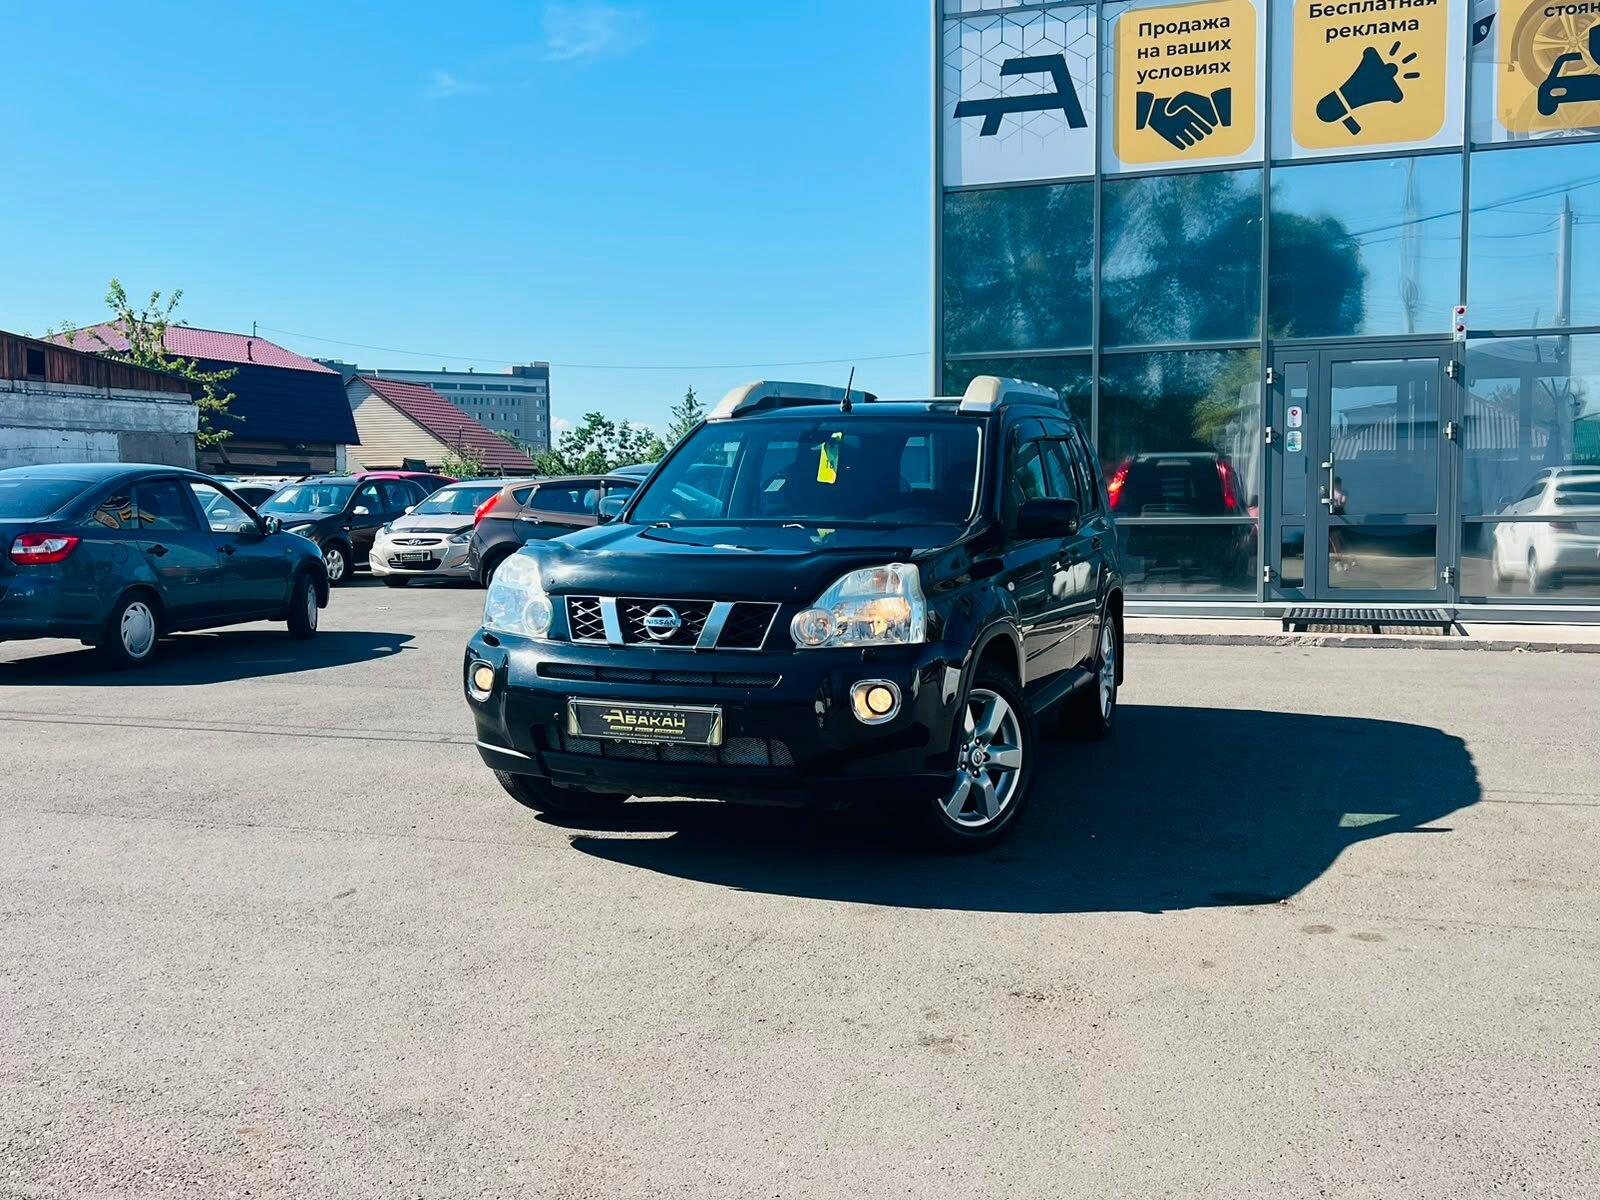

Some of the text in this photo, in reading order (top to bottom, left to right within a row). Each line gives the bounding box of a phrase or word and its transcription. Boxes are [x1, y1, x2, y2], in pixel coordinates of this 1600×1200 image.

[1138, 16, 1230, 38] Продажа
[1326, 19, 1419, 43] реклама
[1137, 39, 1231, 59] на ваших
[1136, 61, 1231, 85] условиях
[646, 618, 677, 626] NISSAN
